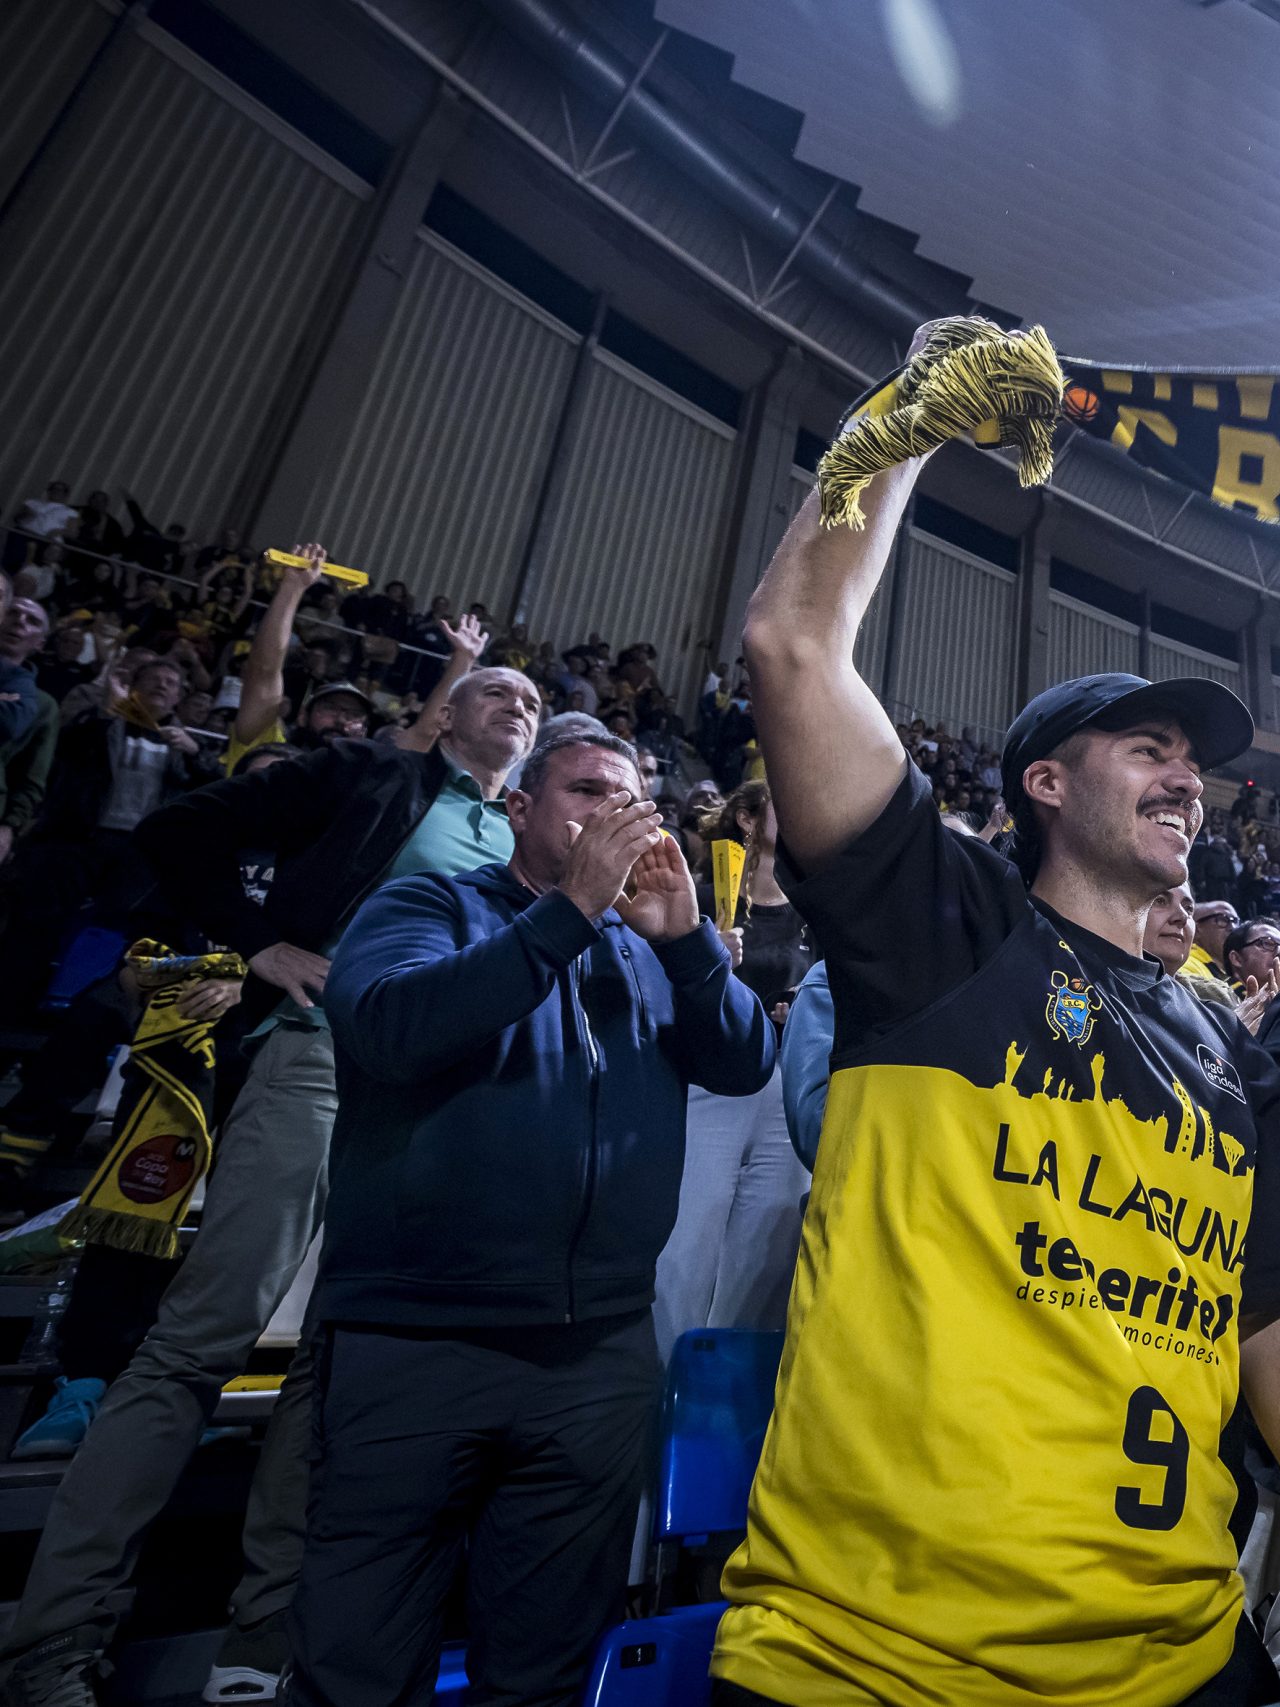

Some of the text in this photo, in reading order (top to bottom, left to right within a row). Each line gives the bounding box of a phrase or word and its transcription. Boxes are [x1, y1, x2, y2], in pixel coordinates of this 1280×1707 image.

[993, 1122, 1061, 1202] LA
[1118, 1323, 1214, 1364] mociones
[1115, 1385, 1190, 1531] 9
